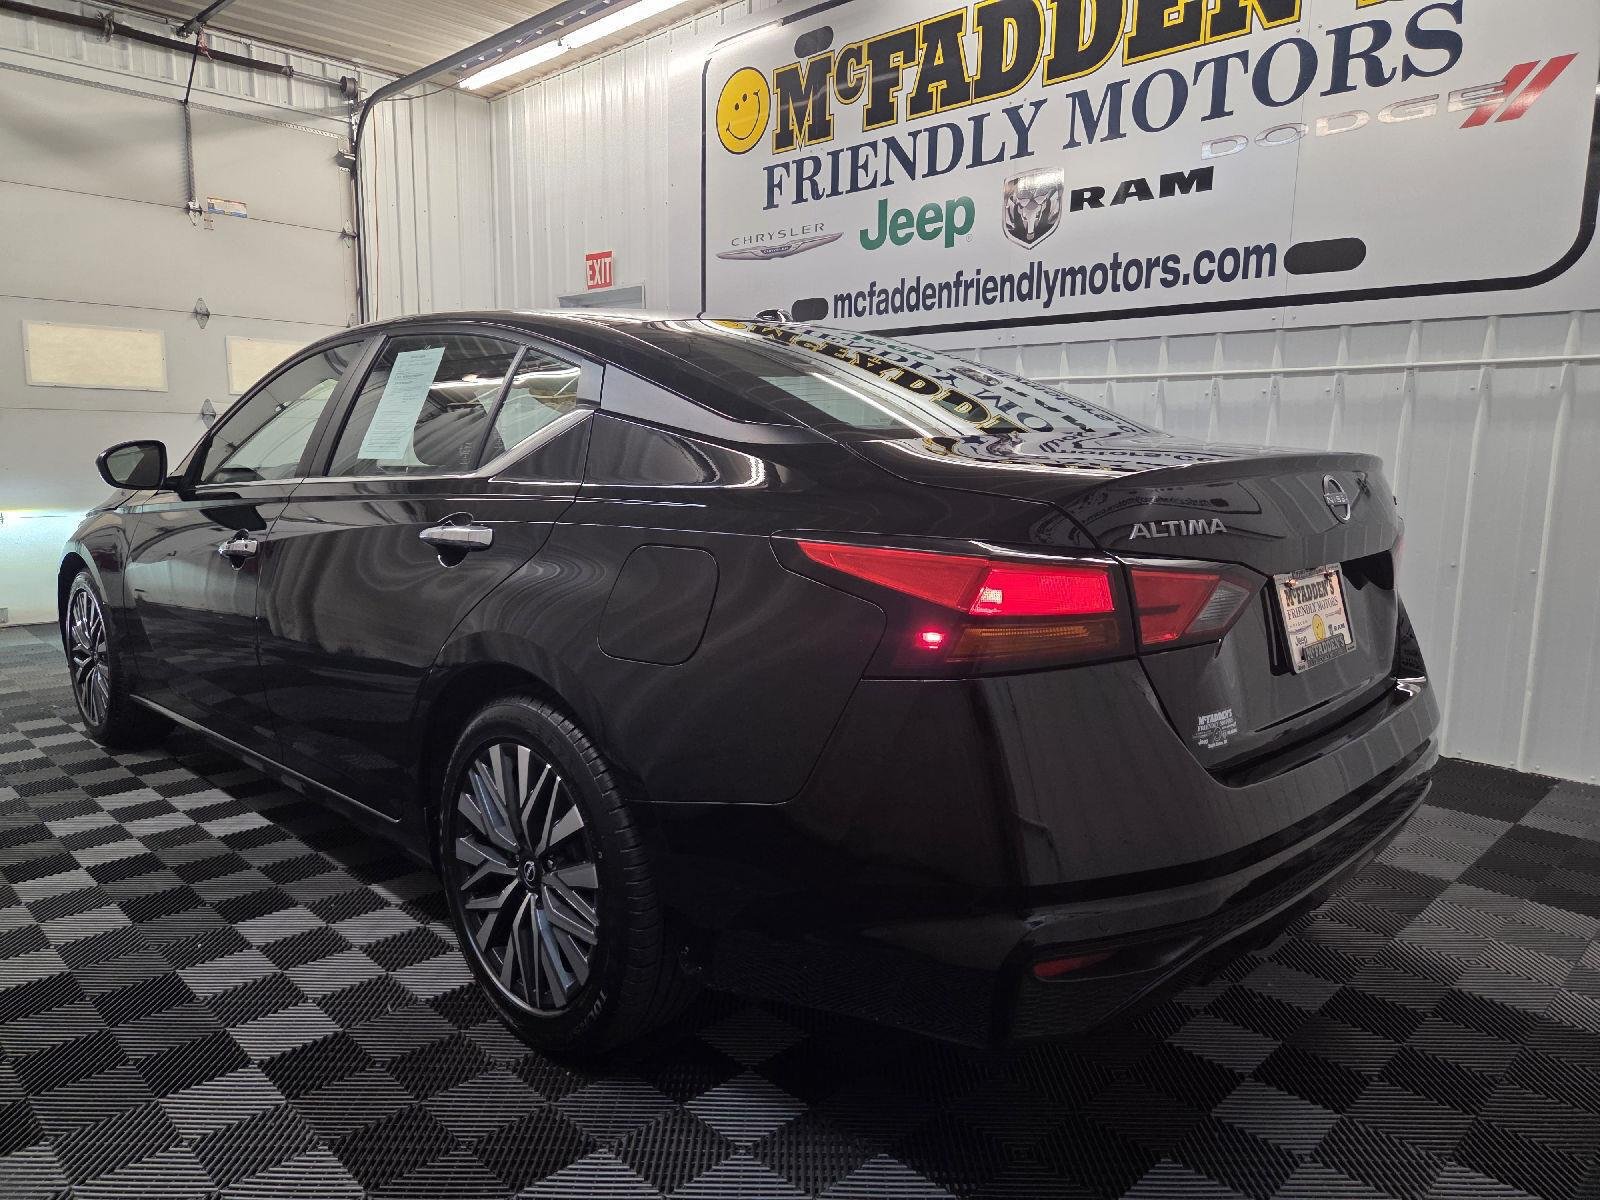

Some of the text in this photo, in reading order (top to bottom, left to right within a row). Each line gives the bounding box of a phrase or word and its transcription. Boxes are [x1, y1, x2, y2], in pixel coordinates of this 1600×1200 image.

[762, 3, 1463, 211] FRIENDLY MOTORS
[1201, 80, 1508, 160] DODGE
[1069, 166, 1214, 213] RAM
[731, 222, 825, 247] CHRYSLER
[859, 196, 975, 250] Jeep
[586, 257, 611, 286] EXIT
[833, 242, 1277, 320] mcfaddenfriendlymotors.com
[1129, 518, 1228, 540] ALTIMA
[1287, 601, 1319, 620] FRIENDLY
